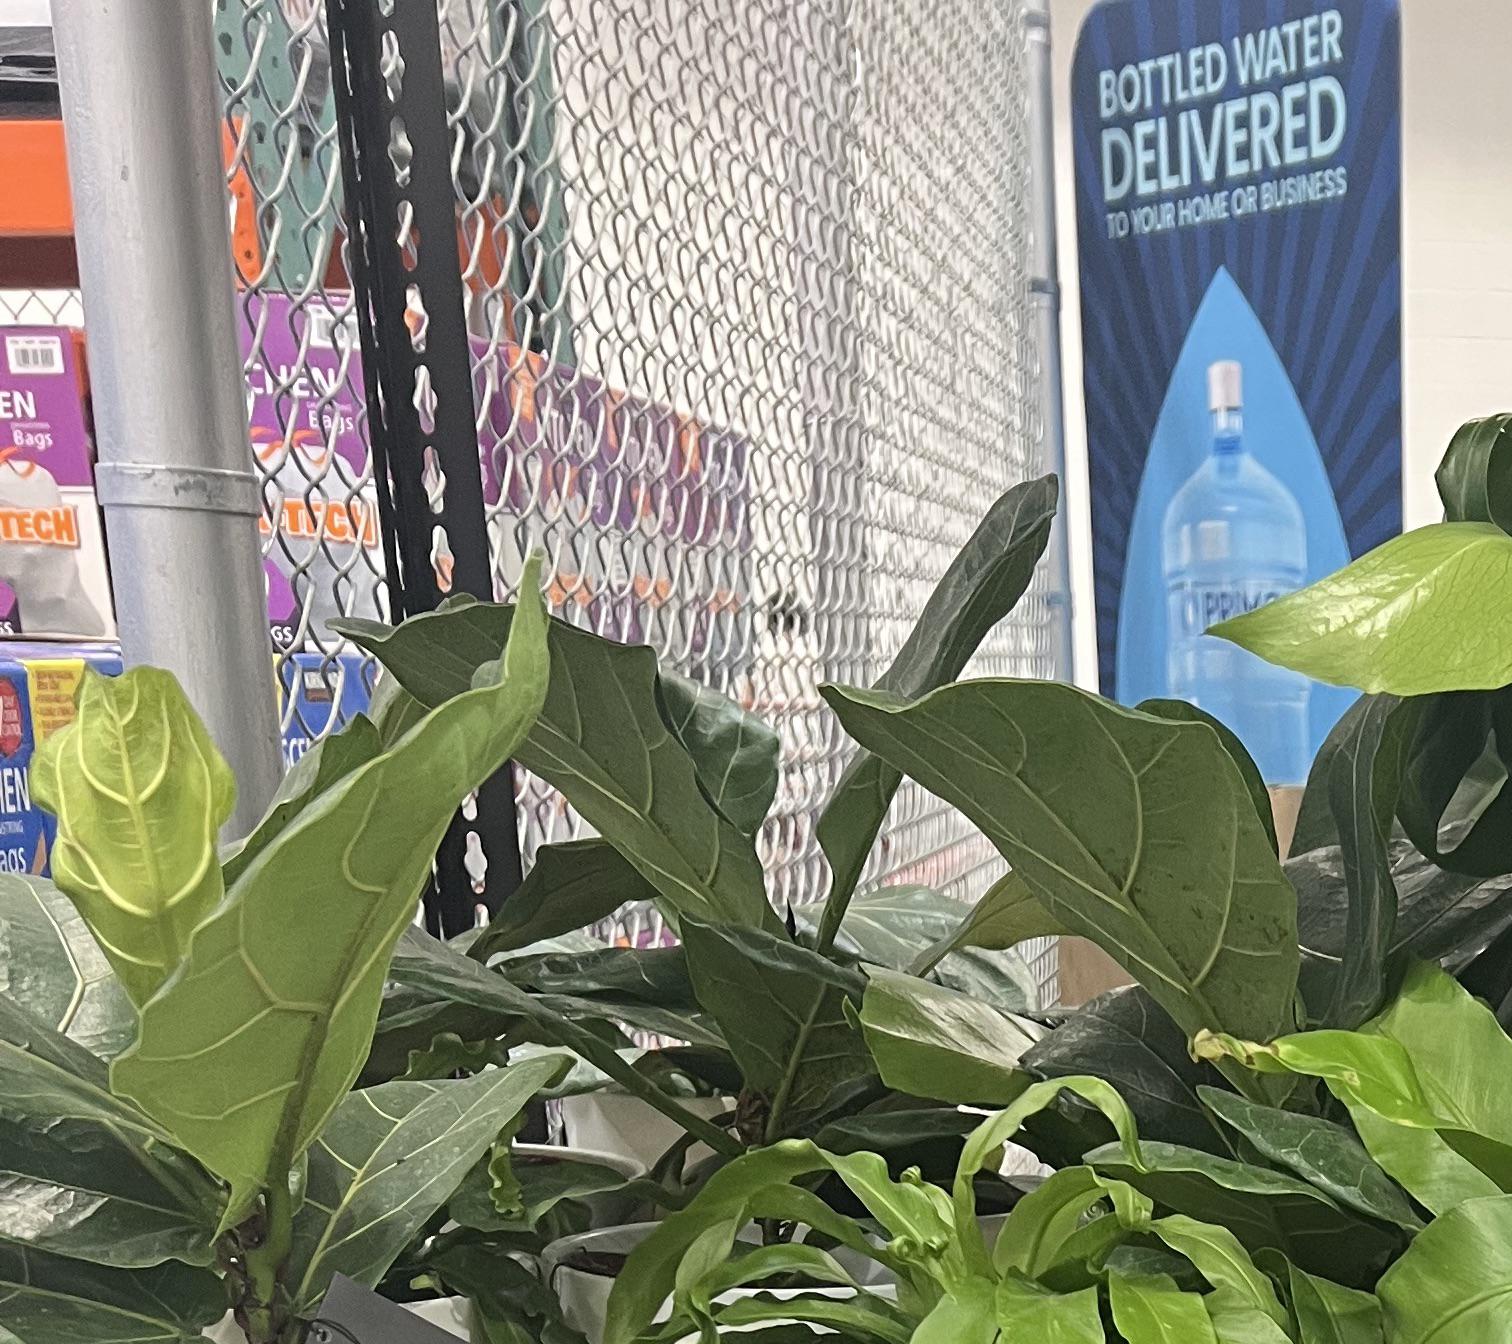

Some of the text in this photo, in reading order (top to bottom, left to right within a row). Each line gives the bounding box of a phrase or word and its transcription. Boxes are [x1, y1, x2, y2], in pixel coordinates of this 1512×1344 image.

[1099, 9, 1344, 120] BOTTLED WATER
[1100, 76, 1347, 202] DELIVERED
[1106, 166, 1347, 239] TO YOUR HOME OR BUSINESS
[13, 429, 53, 450] Bags
